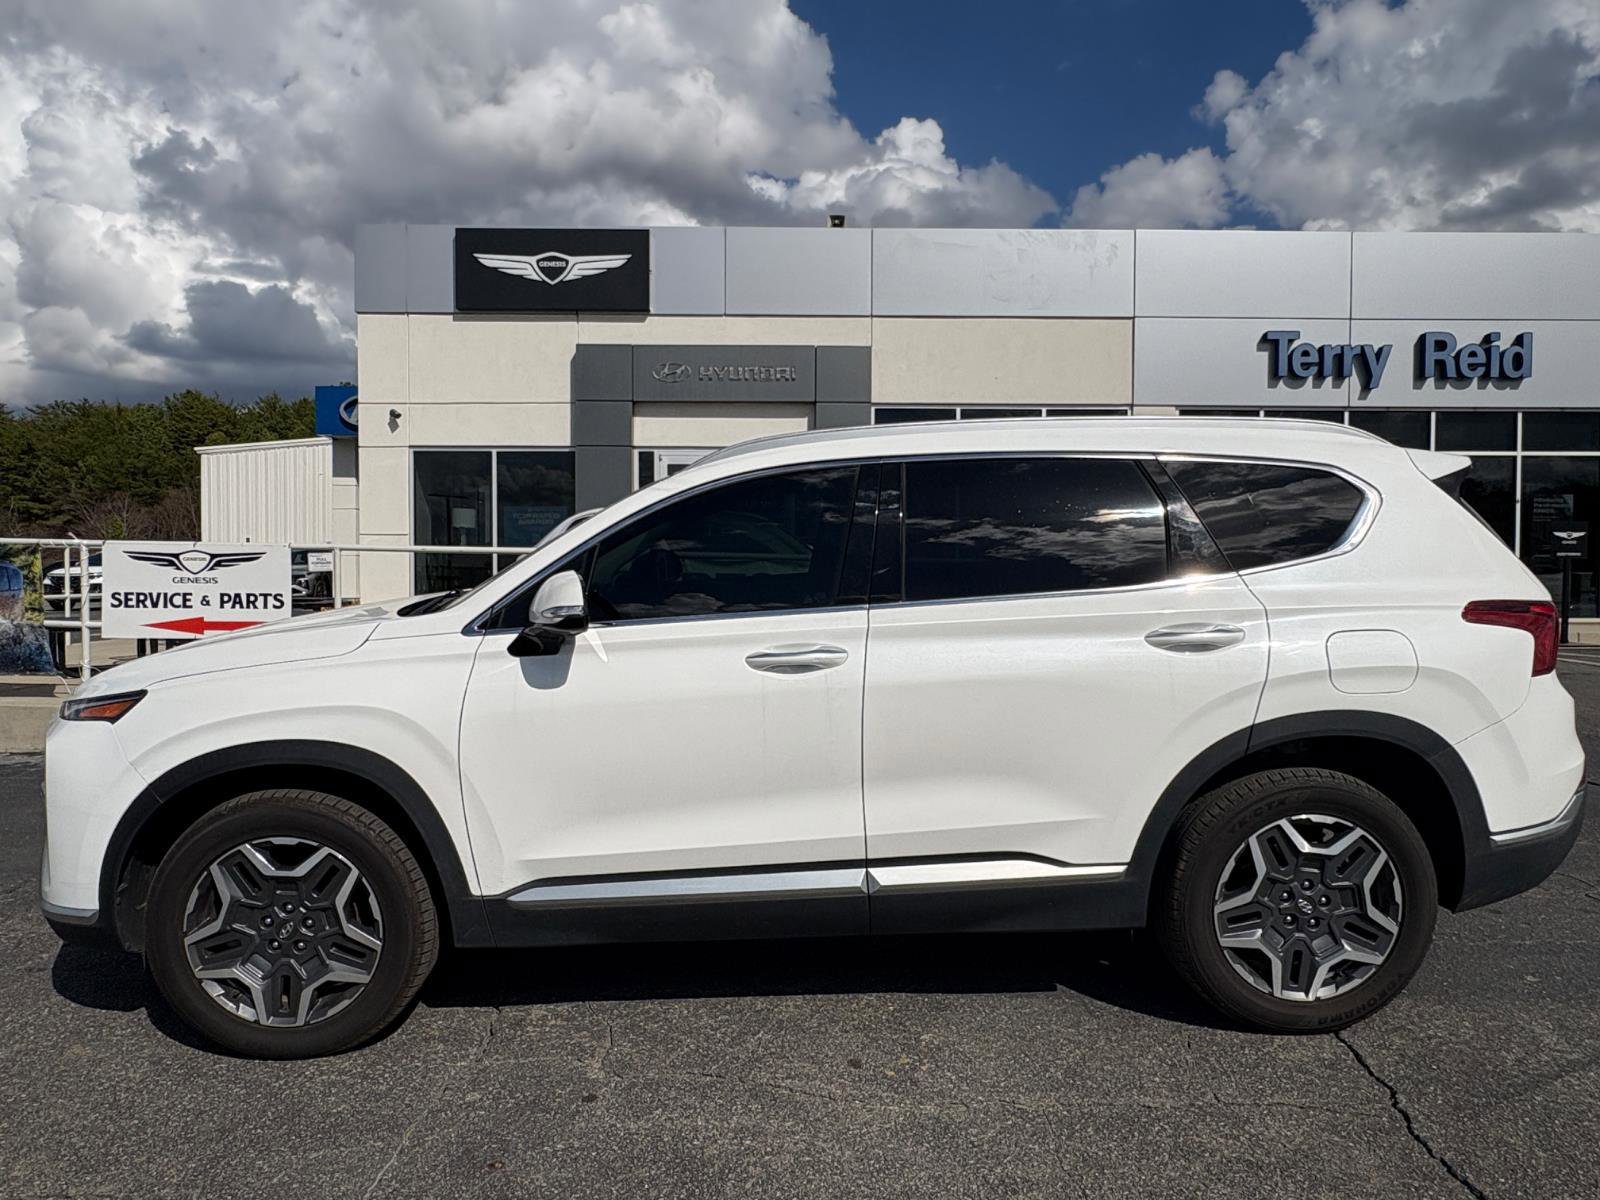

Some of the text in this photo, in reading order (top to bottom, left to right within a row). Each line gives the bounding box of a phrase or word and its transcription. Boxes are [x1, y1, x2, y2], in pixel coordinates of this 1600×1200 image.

[538, 260, 567, 268] GENESIS
[1263, 331, 1534, 390] Terry Reid
[698, 365, 797, 382] HYUNDAI
[172, 576, 219, 584] GENESIS
[110, 591, 285, 609] SERVICE & PARTS
